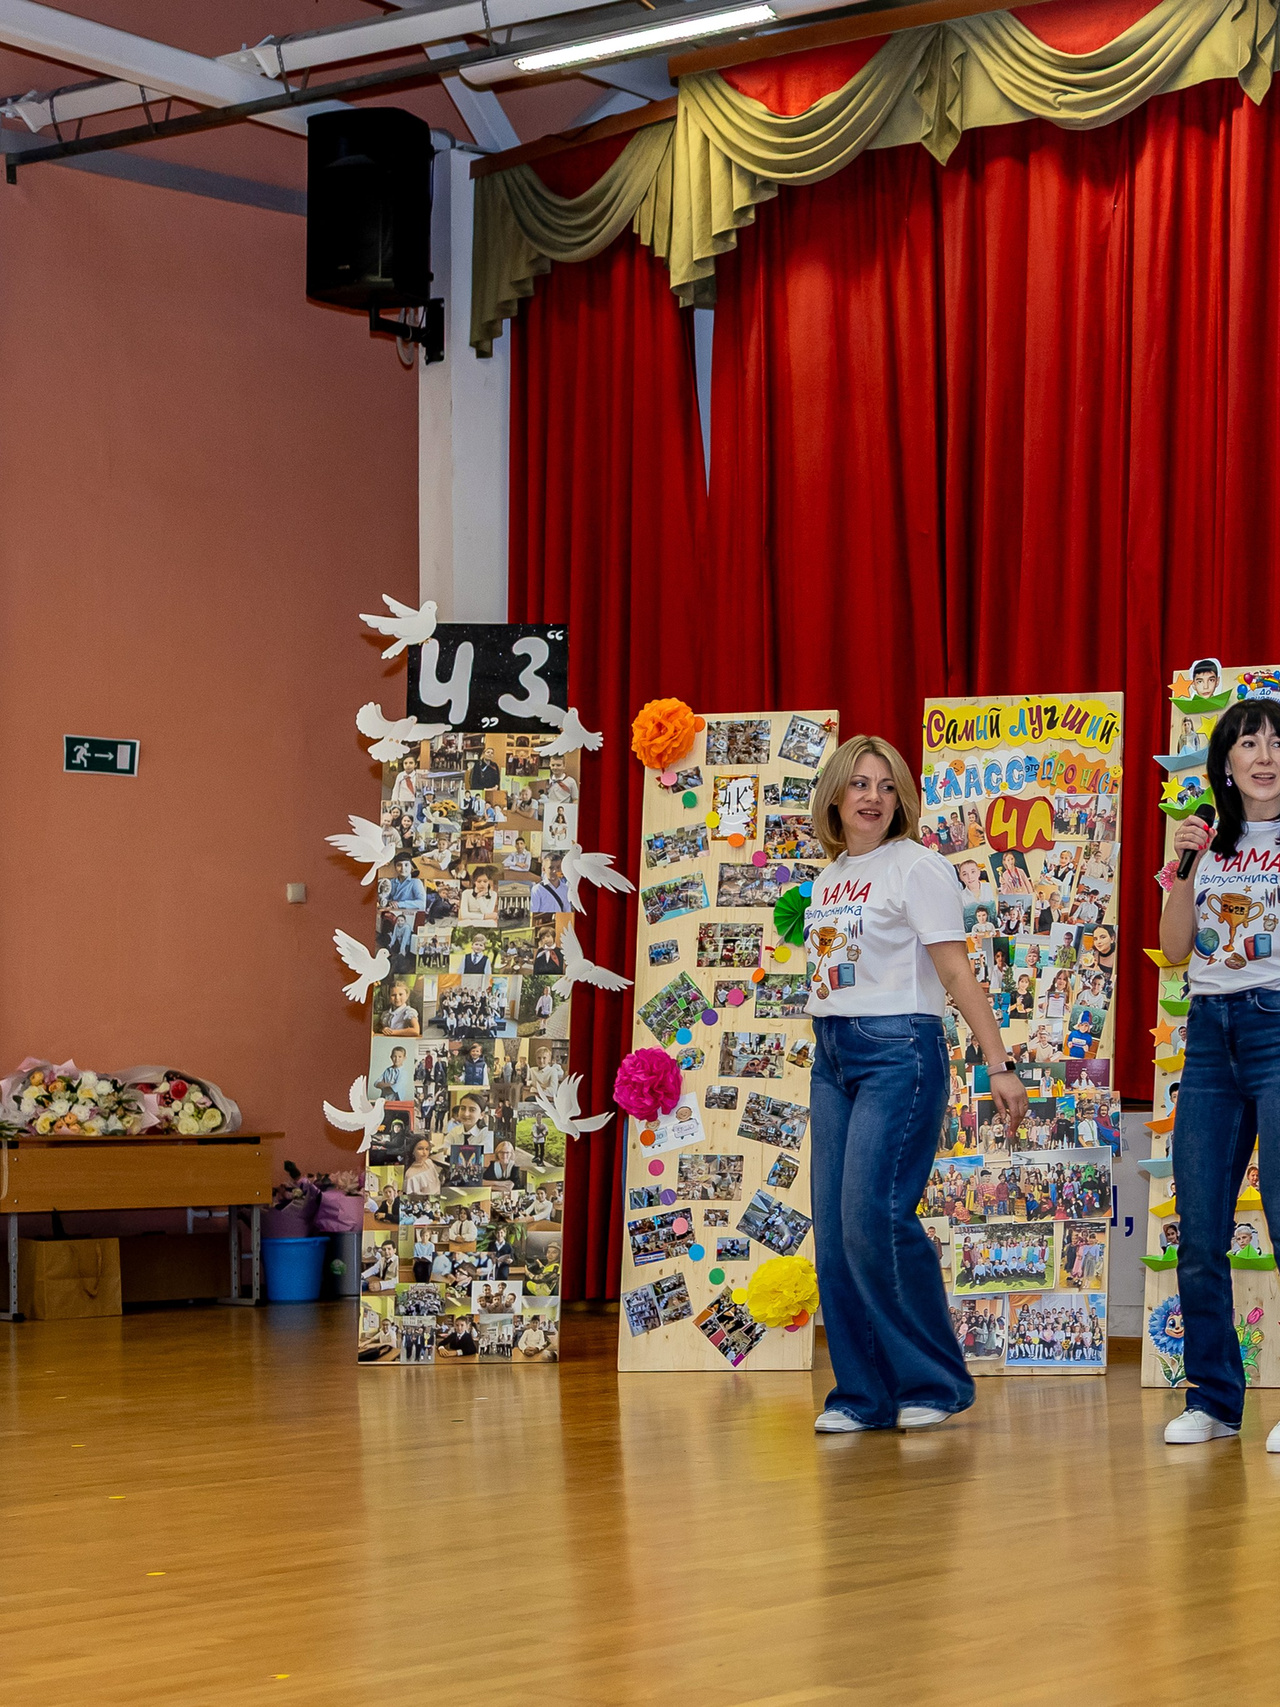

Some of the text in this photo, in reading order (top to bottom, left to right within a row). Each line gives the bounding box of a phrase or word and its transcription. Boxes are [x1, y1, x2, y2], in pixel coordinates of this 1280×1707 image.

[926, 707, 1002, 748] Самый
[923, 755, 1026, 806] КЛАСС
[1041, 757, 1077, 787] ПРО
[1222, 903, 1245, 916] 2025
